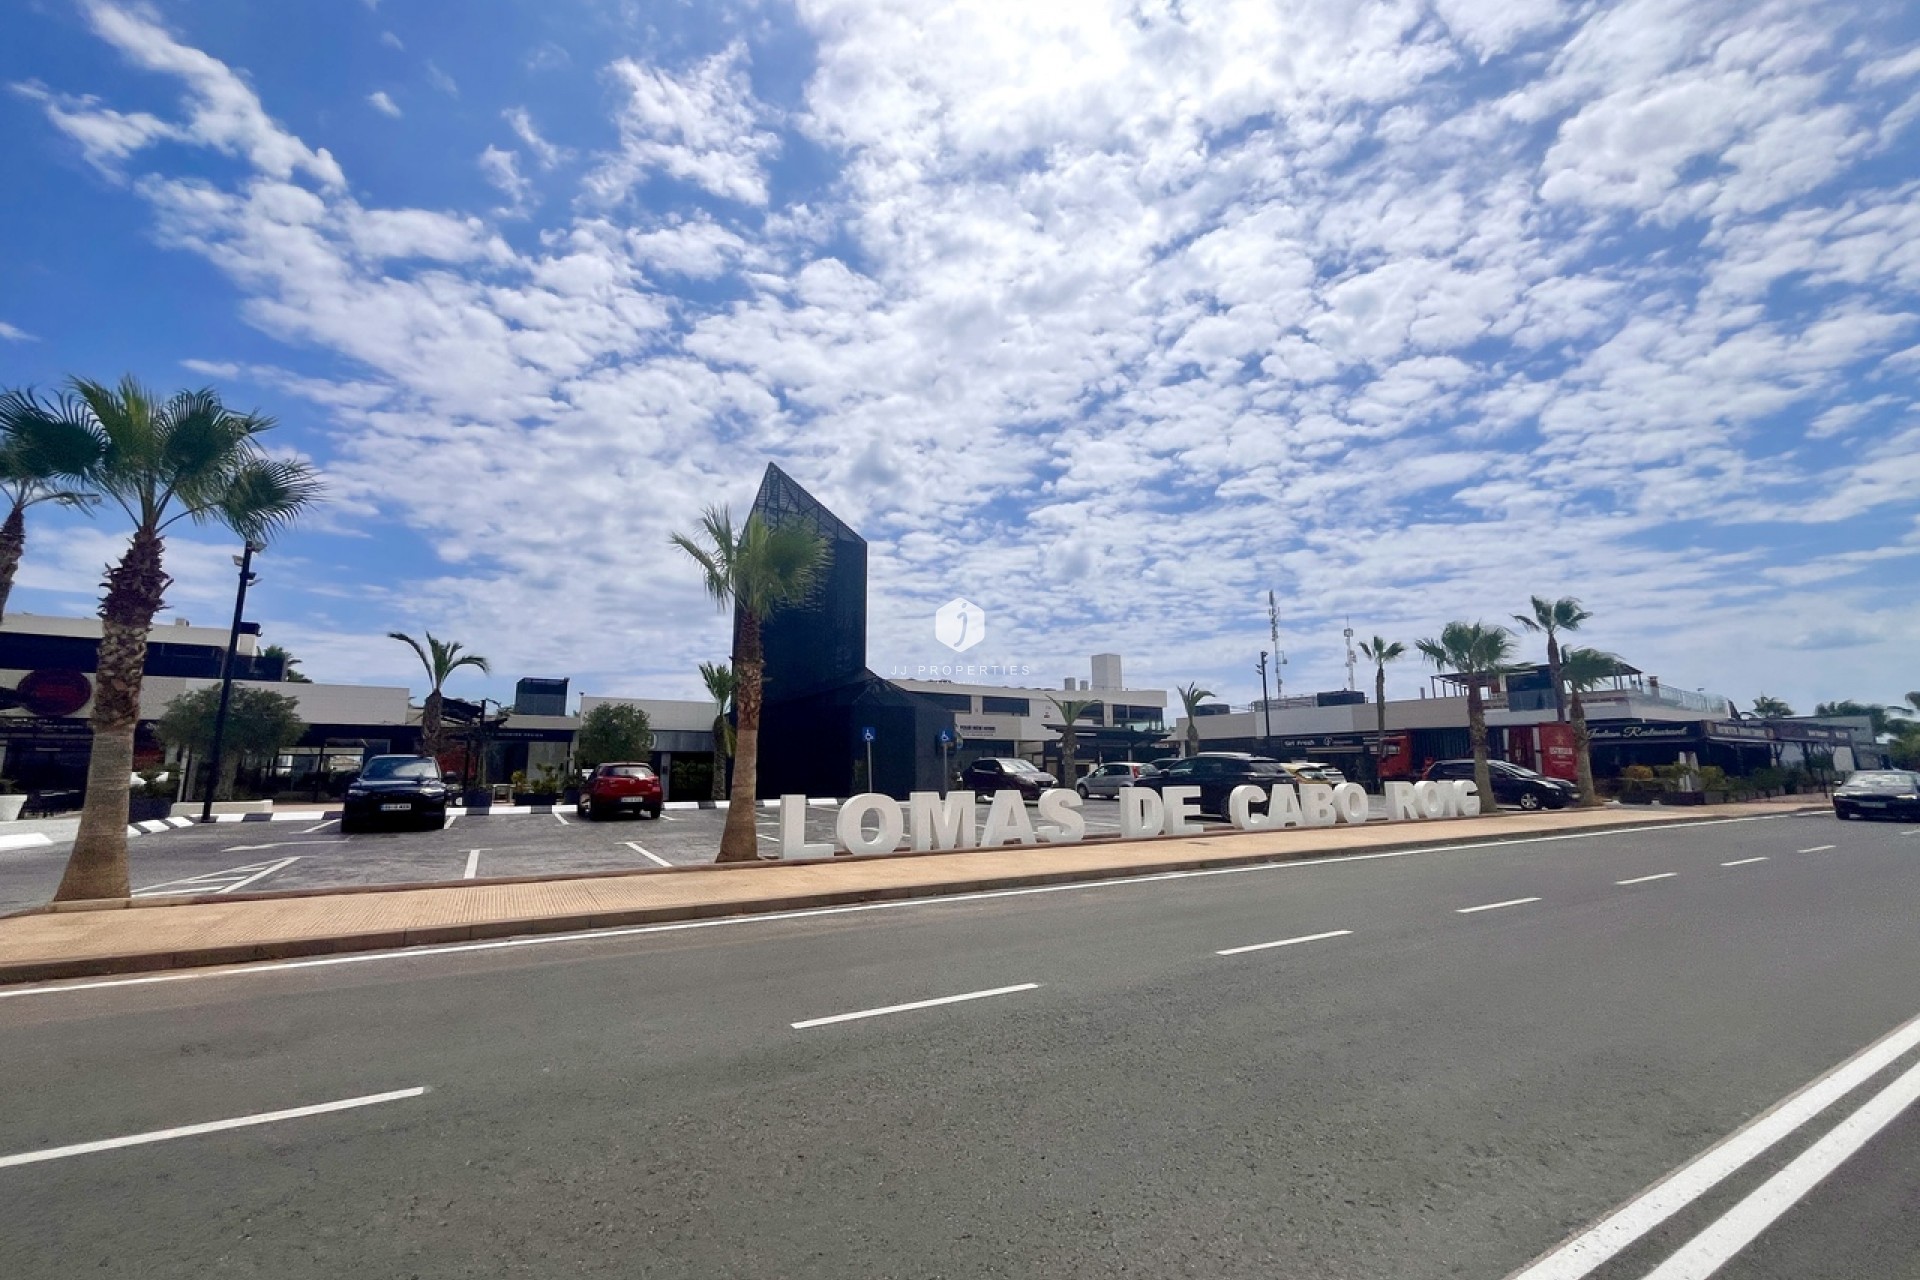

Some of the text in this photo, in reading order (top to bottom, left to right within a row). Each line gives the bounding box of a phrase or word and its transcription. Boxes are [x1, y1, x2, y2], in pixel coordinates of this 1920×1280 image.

[1623, 726, 1688, 738] Restaurant
[779, 788, 1085, 860] LOMAS
[1119, 785, 1203, 838] DE
[1228, 782, 1369, 831] CABO
